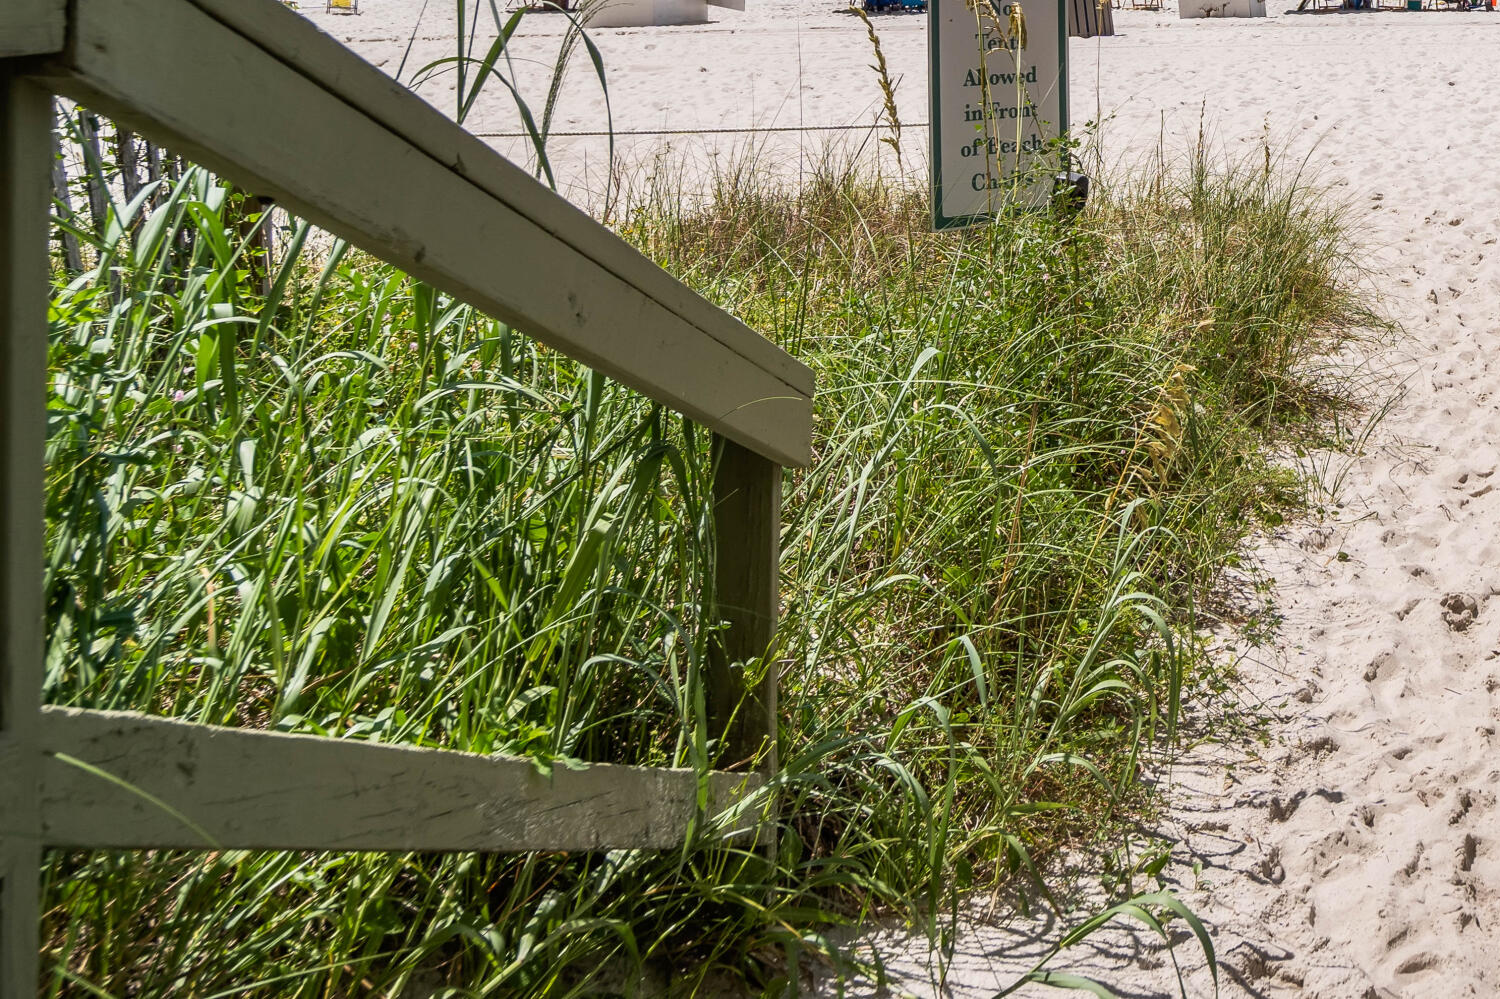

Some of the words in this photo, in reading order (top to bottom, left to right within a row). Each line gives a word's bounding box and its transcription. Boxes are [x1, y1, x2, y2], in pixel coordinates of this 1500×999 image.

[986, 0, 1013, 17] No
[975, 33, 1025, 51] Tent
[963, 66, 1037, 87] Alowed
[964, 104, 983, 122] in
[960, 137, 982, 158] of
